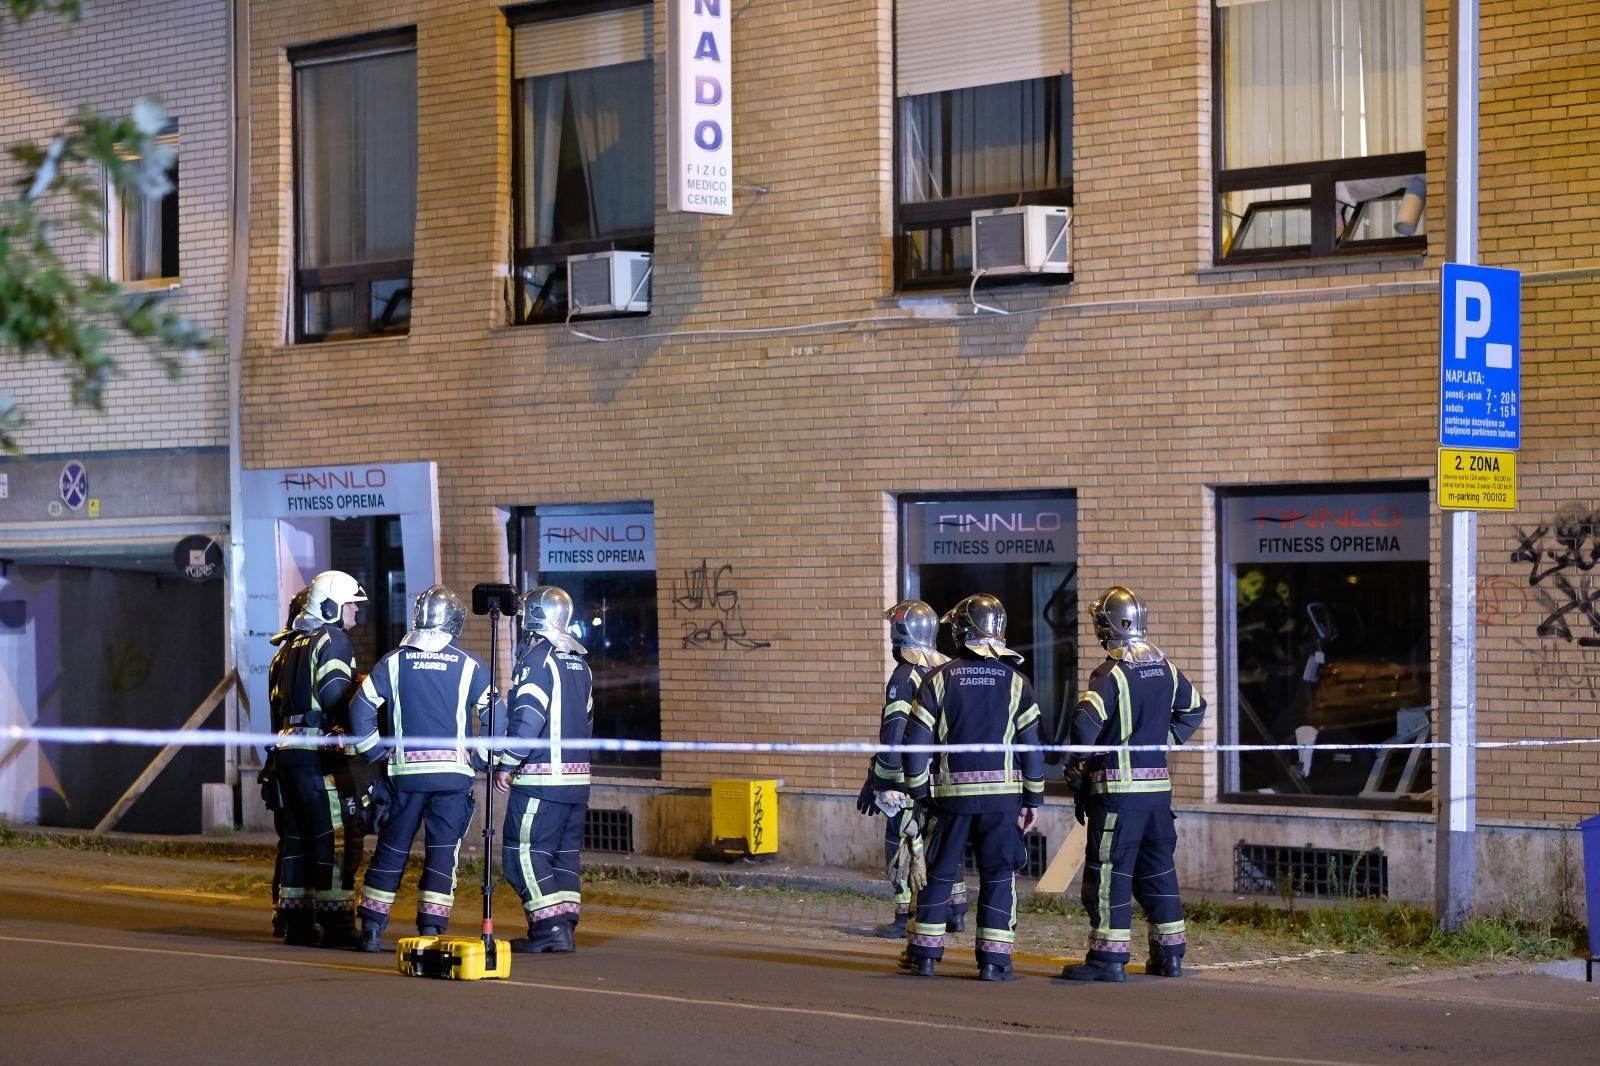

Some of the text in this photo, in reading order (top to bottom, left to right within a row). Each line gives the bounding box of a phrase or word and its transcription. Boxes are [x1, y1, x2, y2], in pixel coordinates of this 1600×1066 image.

[687, 163, 727, 177] FIZIO
[687, 178, 727, 192] MEDICO
[687, 193, 727, 207] CENTAR
[1455, 280, 1492, 359] P
[1445, 369, 1485, 385] NAPLATA:
[1486, 388, 1492, 401] 7
[1500, 391, 1510, 405] 20
[1511, 389, 1516, 403] h
[1486, 402, 1492, 415] 7
[1500, 405, 1510, 418] 15
[1511, 404, 1516, 417] h
[1455, 455, 1500, 472] 2. ZONA
[284, 469, 387, 491] FINNLO
[288, 493, 386, 511] FITNESS OPREMA
[1448, 492, 1507, 503] m-parking 700102
[938, 512, 1061, 533] FINNLO
[1257, 506, 1403, 529] FINNLO
[547, 525, 646, 544] FINNLO
[933, 538, 1055, 555] FITNESS OPREMA
[1259, 535, 1400, 553] FITNESS OPREMA
[548, 549, 646, 564] FITNESS OPREMA
[949, 666, 1006, 677] VATROGASCI
[959, 677, 996, 686] ZAGREB
